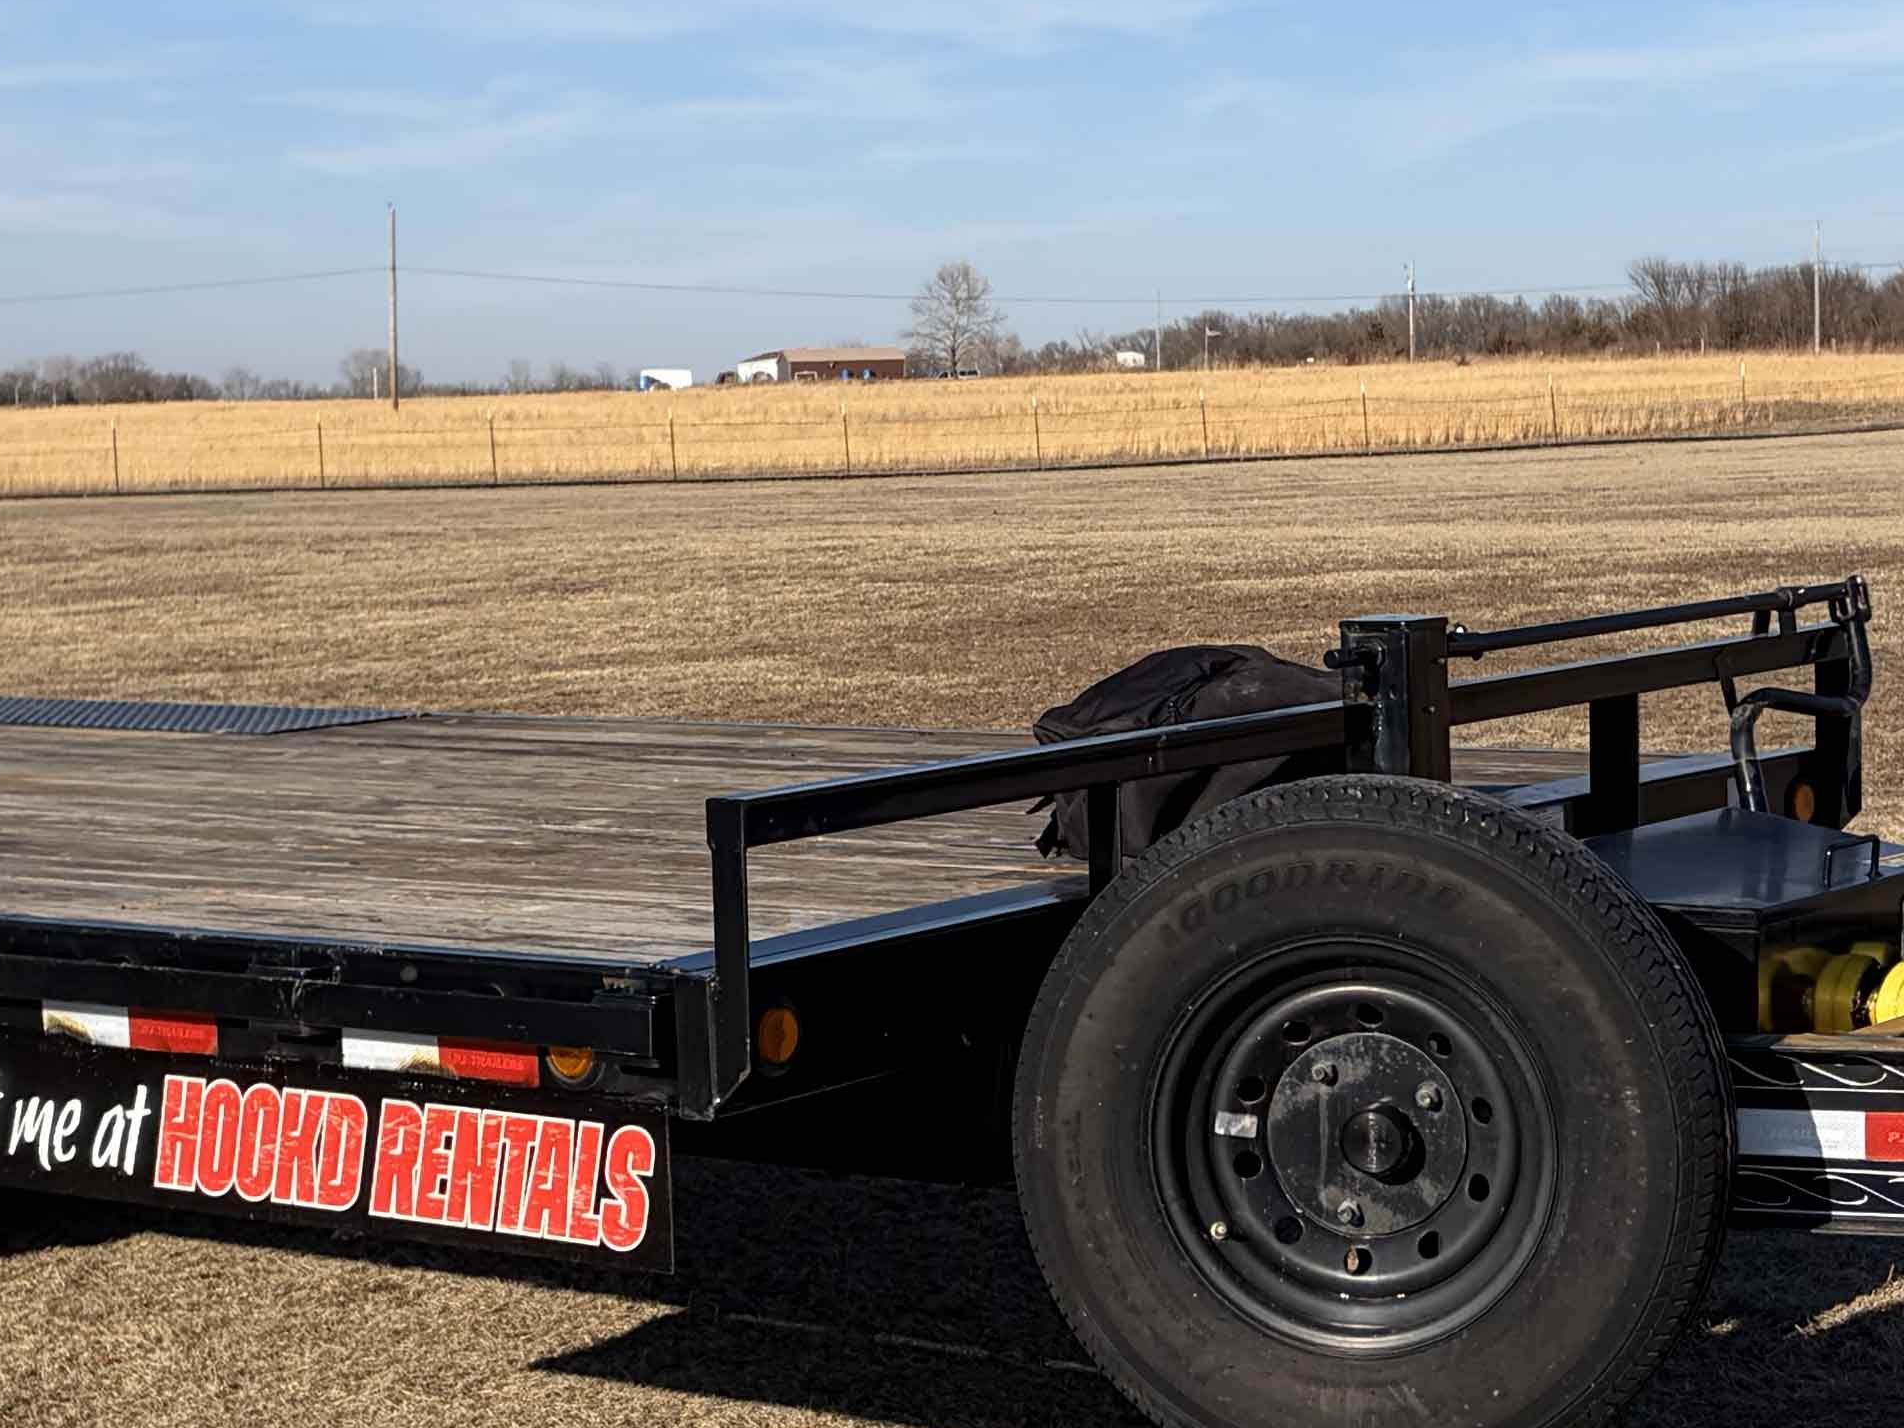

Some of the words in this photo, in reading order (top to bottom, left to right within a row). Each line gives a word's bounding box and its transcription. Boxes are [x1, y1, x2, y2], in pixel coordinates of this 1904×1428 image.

[8, 1095, 82, 1171] me
[91, 1084, 152, 1176] at
[153, 1074, 369, 1212] HOOKD
[368, 1097, 656, 1253] RENTALS
